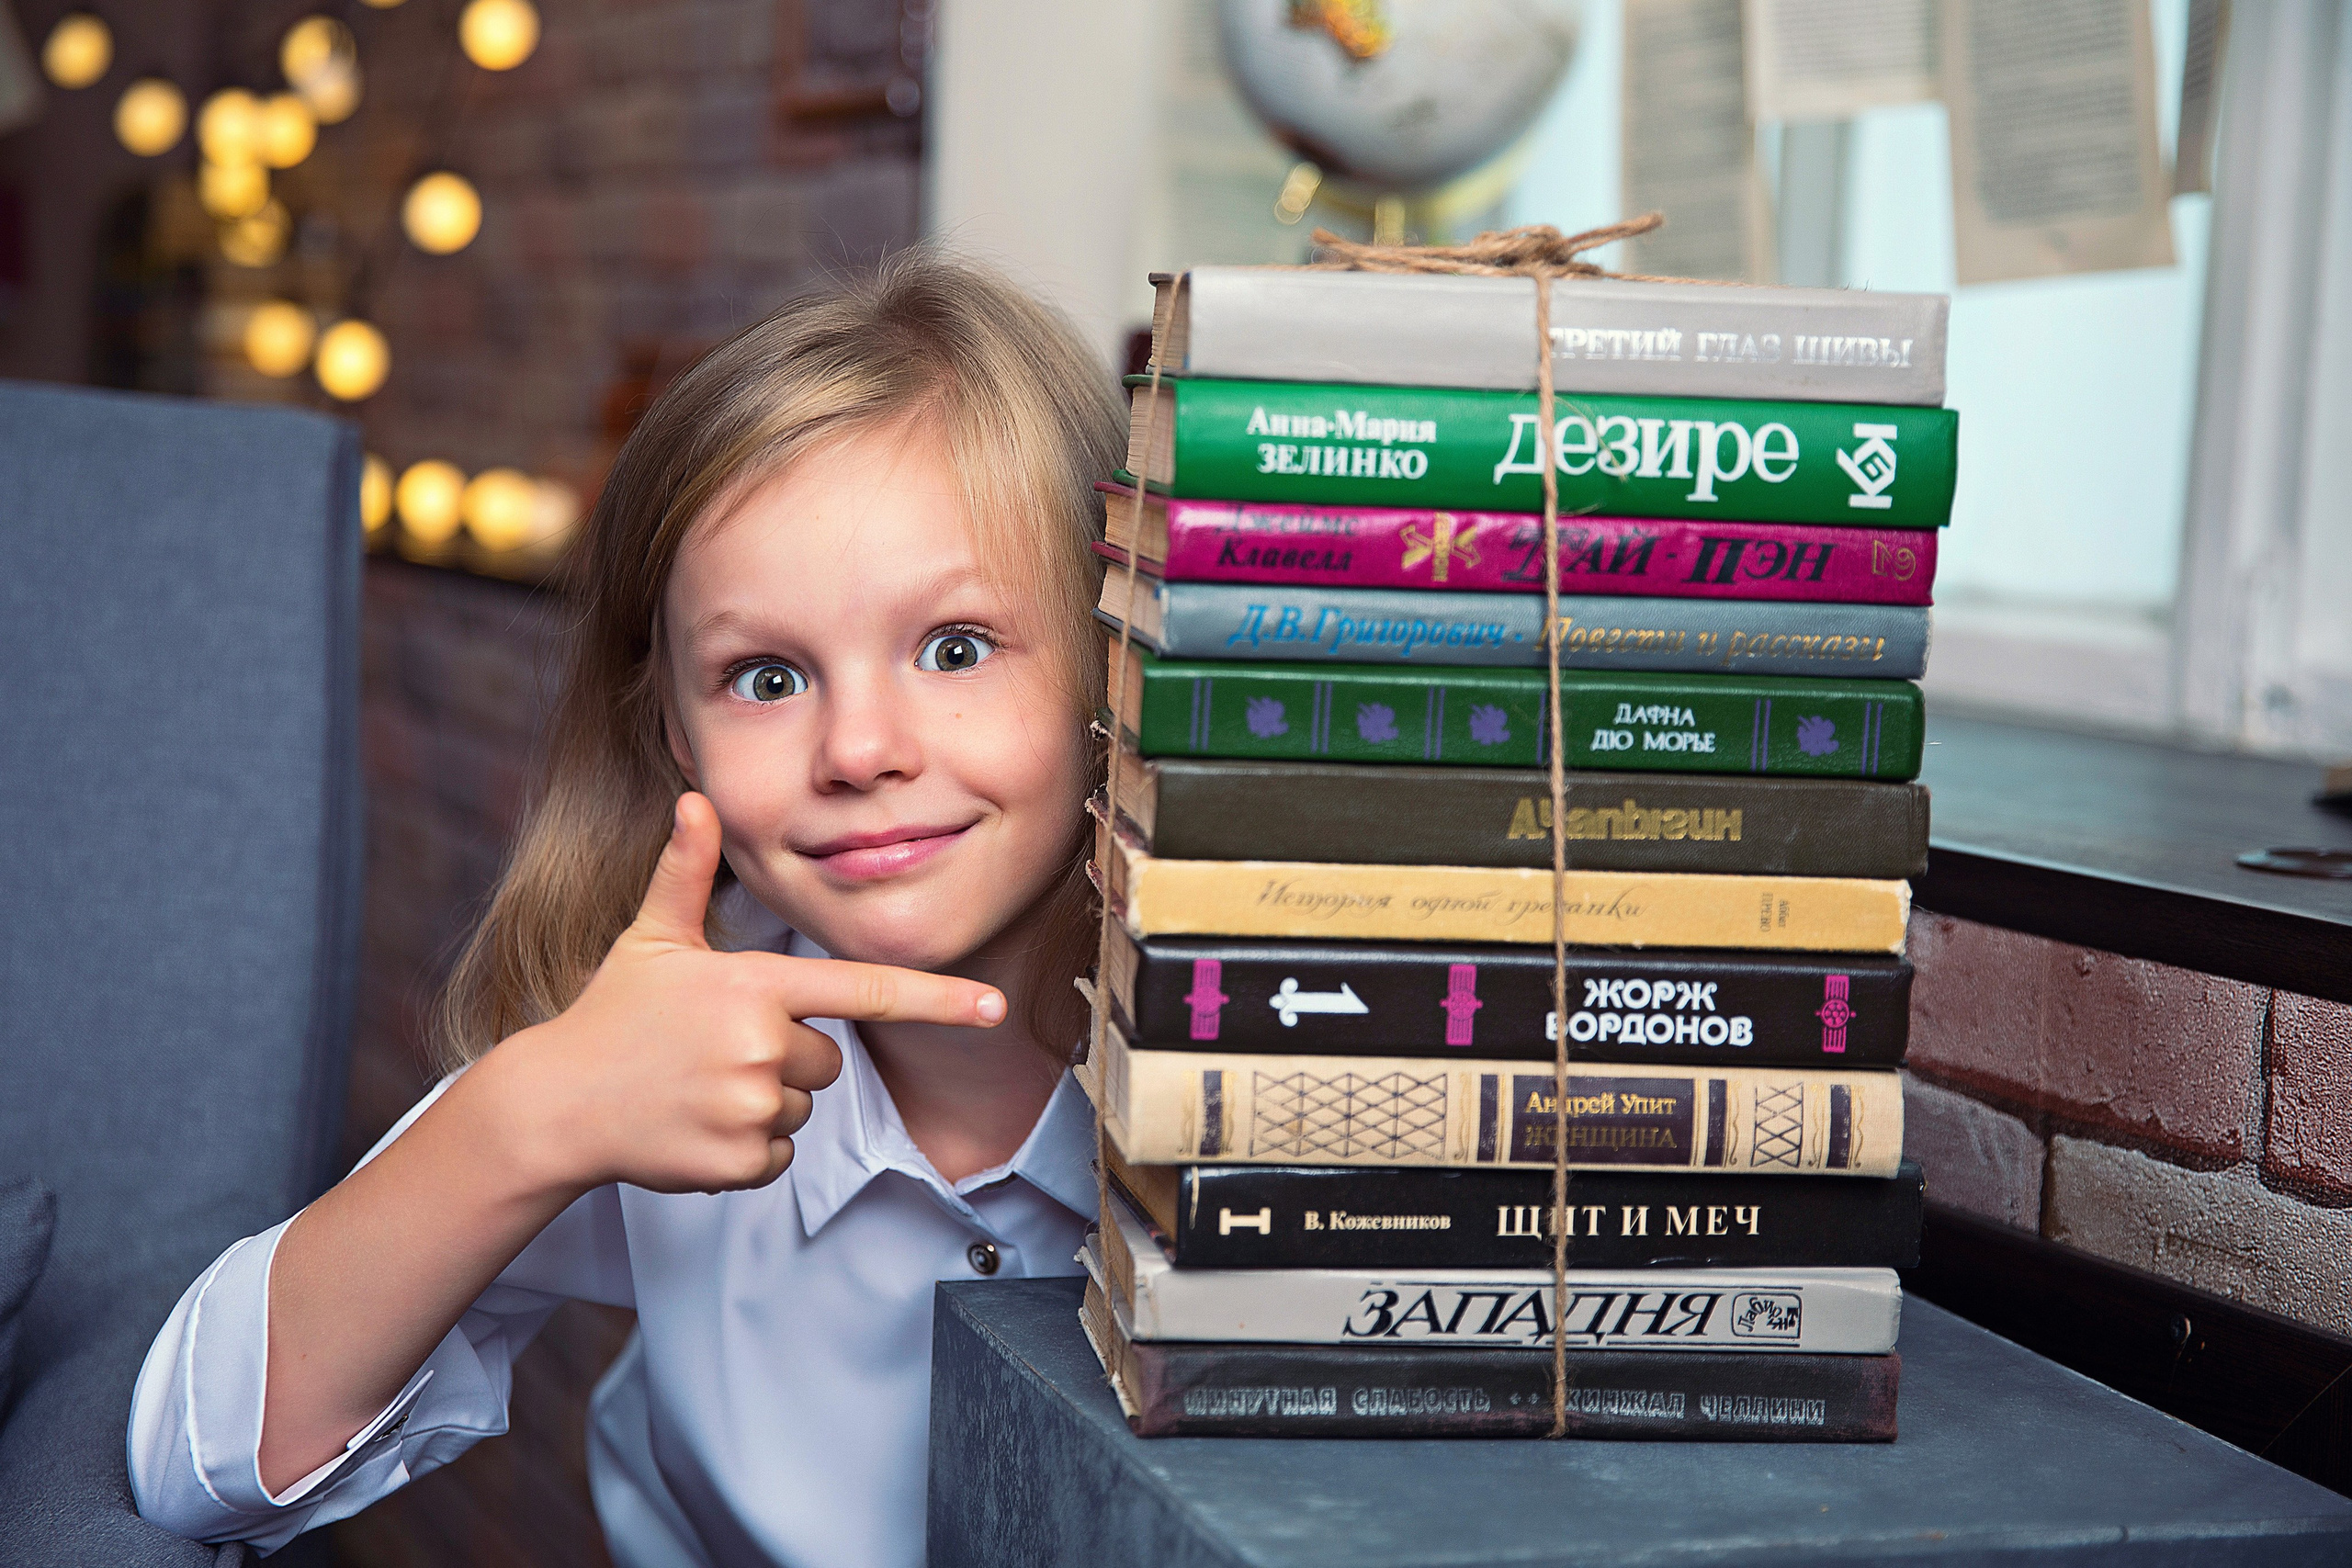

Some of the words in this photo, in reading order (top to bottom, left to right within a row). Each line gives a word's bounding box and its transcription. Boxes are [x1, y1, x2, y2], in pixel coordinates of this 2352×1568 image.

[1694, 331, 1781, 365] ГЛАЗ
[1792, 334, 1914, 368] ШИВЫ
[1255, 442, 1429, 480] ЗЕЛИНКО
[1216, 537, 1353, 571] Клавелл
[1533, 615, 1687, 654] Повести
[1696, 630, 1719, 657] и
[1721, 629, 1886, 667] рассказы
[1612, 702, 1696, 728] ДАФНА
[1589, 728, 1634, 752] ДЮ
[1642, 730, 1717, 753] МОРЬЕ
[1253, 877, 1396, 920] История
[1406, 888, 1502, 921] одной
[1582, 977, 1718, 1011] ЖОРЖ
[1620, 1092, 1678, 1115] Упит
[1304, 1211, 1325, 1231] В.
[1329, 1210, 1453, 1231] Кожевников
[1496, 1204, 1606, 1241] ЩИТ
[1620, 1205, 1650, 1236] И
[1664, 1205, 1762, 1236] МЕЧ
[1342, 1288, 1726, 1347] ЗАПАДНЯ
[1351, 1387, 1492, 1416] СЛАБОСТЬ
[1699, 1393, 1826, 1427] ЧЕЛЛИНИ
